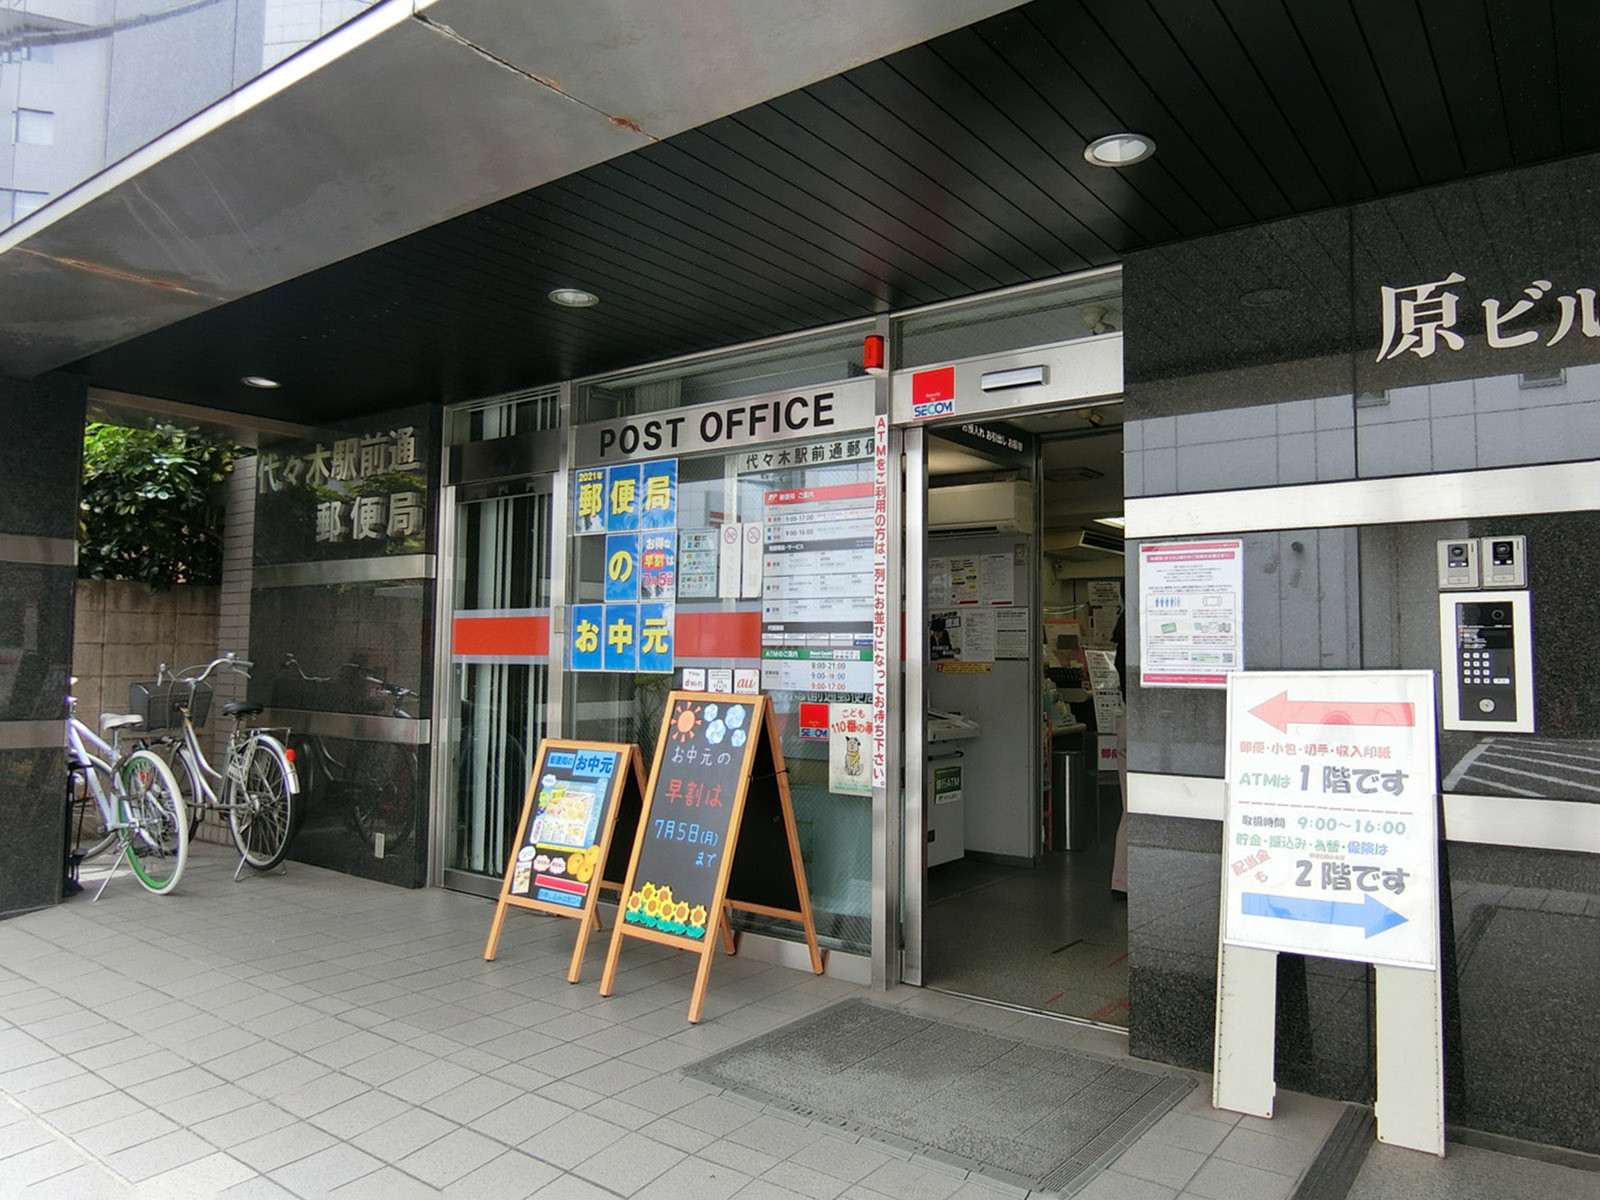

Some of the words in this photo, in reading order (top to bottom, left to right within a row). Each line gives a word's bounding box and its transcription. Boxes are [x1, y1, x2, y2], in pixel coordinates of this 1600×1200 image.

[600, 418, 685, 457] POST
[700, 392, 834, 443] OFFICE
[914, 401, 953, 417] SECOM
[258, 426, 421, 494] 代々木駅前通
[578, 475, 671, 517] 郵便局
[316, 492, 425, 543] 郵便局
[609, 550, 633, 582] の
[575, 618, 669, 654] お中元
[575, 755, 613, 773] お中元
[671, 745, 732, 766] お中元の
[665, 778, 723, 808] 早割は
[1242, 815, 1286, 829] 取扱時間
[1295, 860, 1411, 895] 2階です
